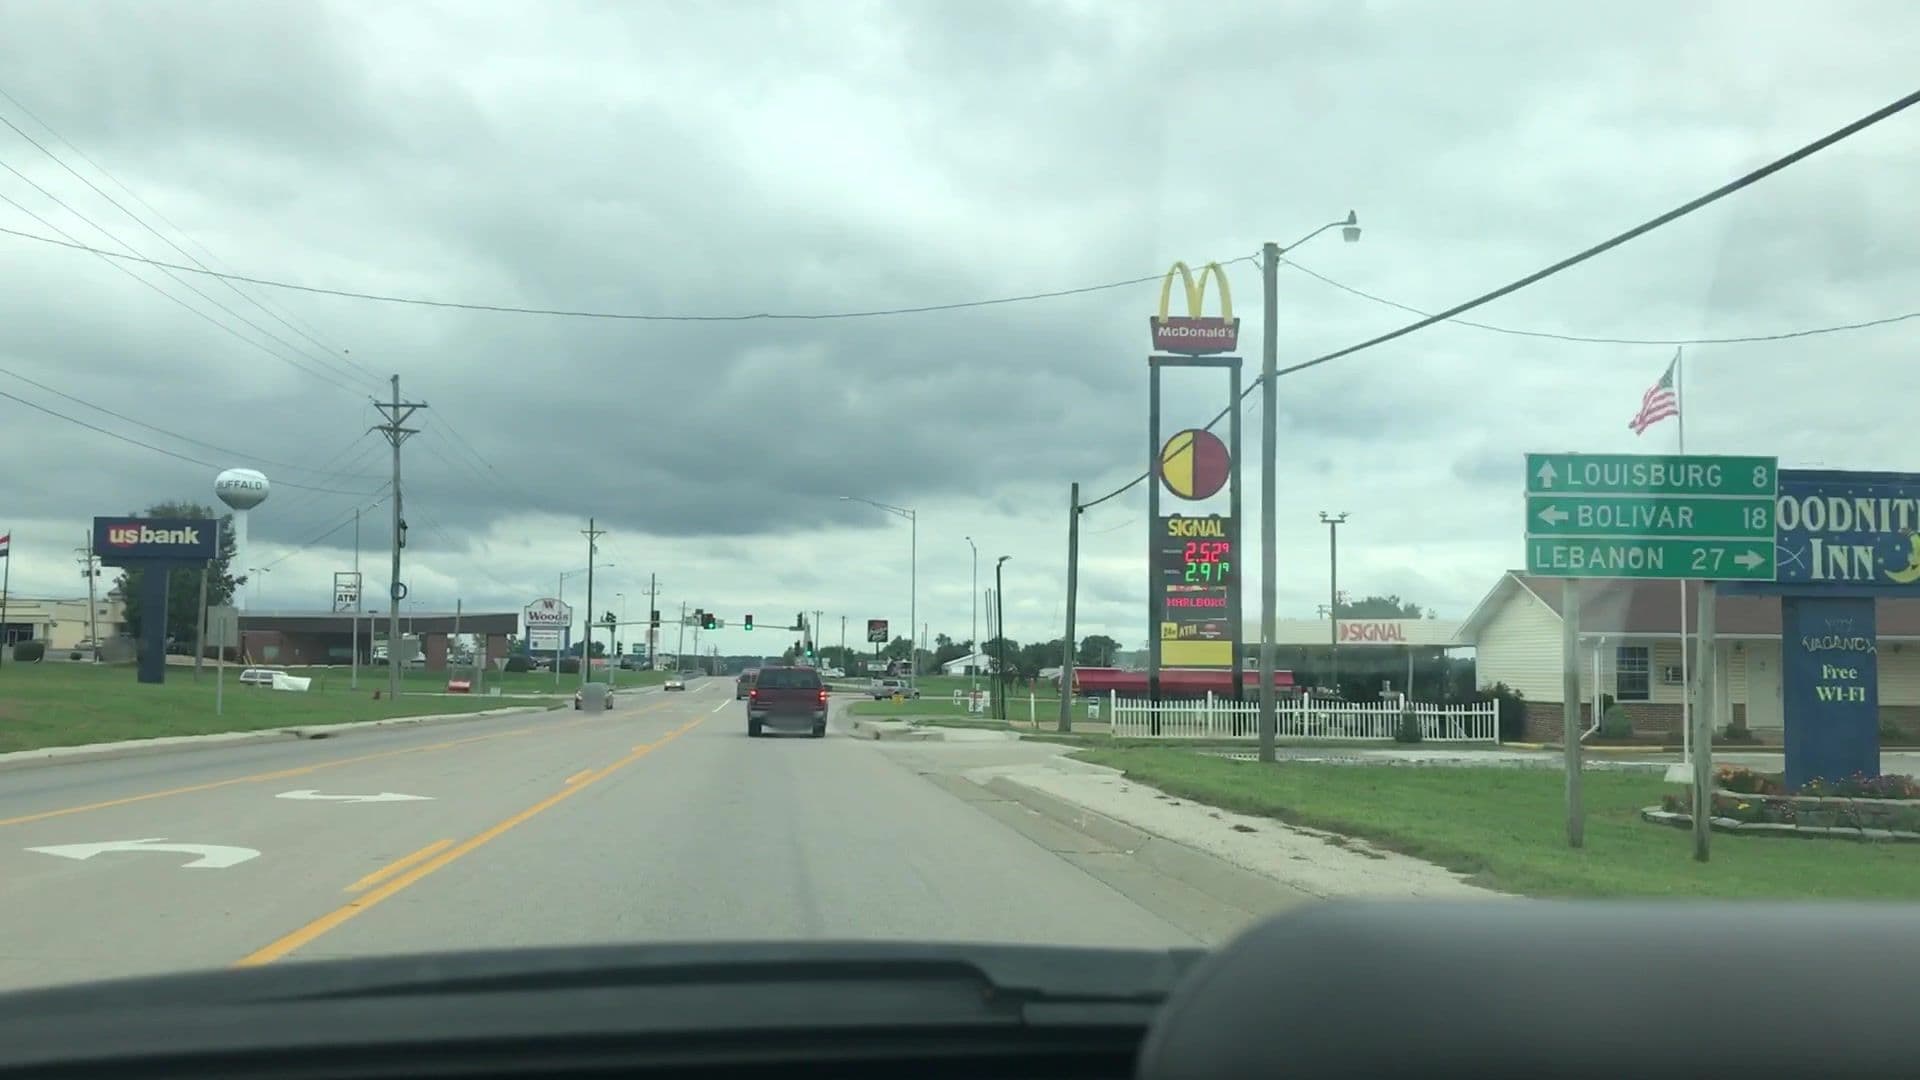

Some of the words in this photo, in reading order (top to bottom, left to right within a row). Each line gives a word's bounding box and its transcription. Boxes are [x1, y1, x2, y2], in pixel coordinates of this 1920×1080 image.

[1158, 326, 1235, 338] McDonald's
[1567, 463, 1722, 488] LOUISBURG
[1752, 465, 1768, 488] 8
[217, 480, 263, 490] BUFFALO
[1577, 504, 1694, 529] BOLIVAR
[1743, 507, 1768, 529] 18
[1776, 495, 1920, 533] OODNIT
[1168, 519, 1225, 537] SIGNAL
[1535, 545, 1664, 570] LEBANON
[1691, 548, 1725, 570] 27
[337, 594, 357, 602] ATM
[1167, 597, 1227, 607] MARLBORO
[1350, 623, 1406, 641] SIGNAL
[1802, 635, 1877, 655] VACANCY
[1822, 664, 1858, 680] Free
[1815, 686, 1865, 702] WI-FI
